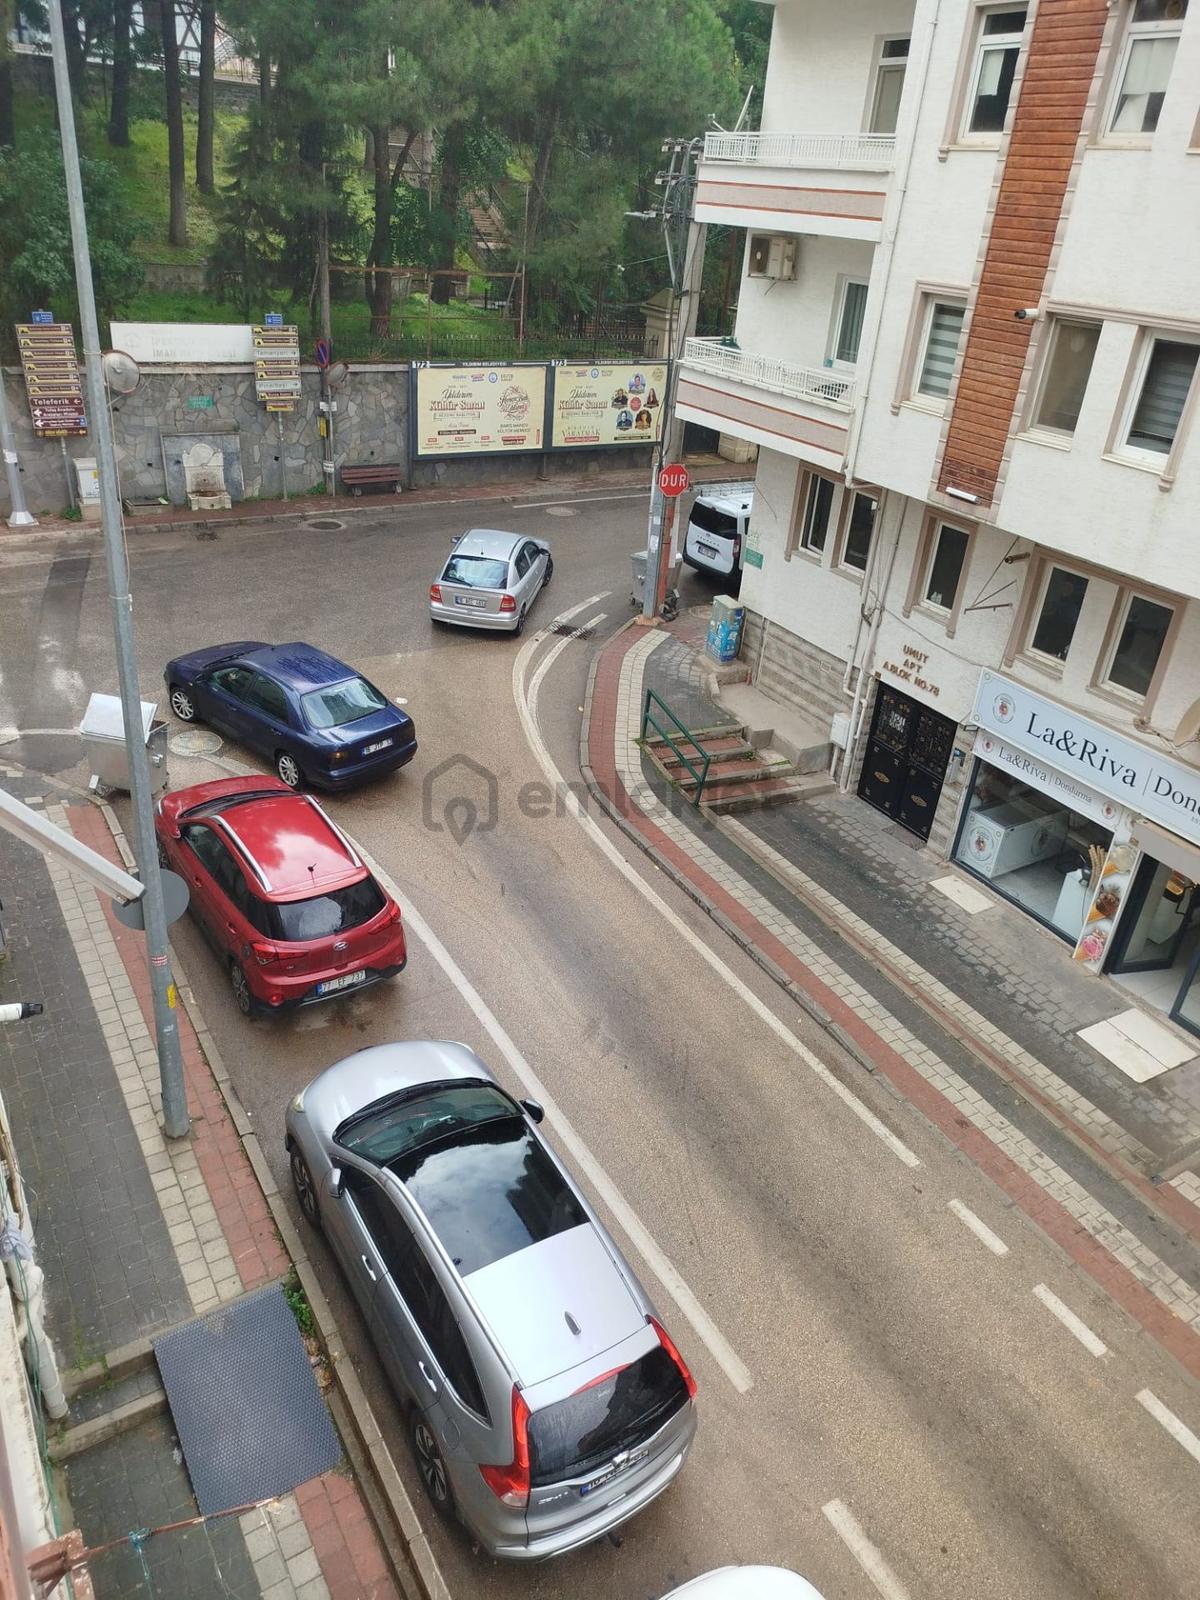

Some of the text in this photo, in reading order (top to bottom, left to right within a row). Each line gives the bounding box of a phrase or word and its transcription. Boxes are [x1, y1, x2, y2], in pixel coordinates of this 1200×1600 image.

[661, 474, 687, 487] DUR
[903, 644, 929, 663] UMUT
[903, 659, 922, 673] APT
[1025, 711, 1137, 788] La&Riva
[998, 746, 1047, 782] La&Riva
[1054, 776, 1092, 802] Dondurma
[1153, 775, 1200, 816] Don
